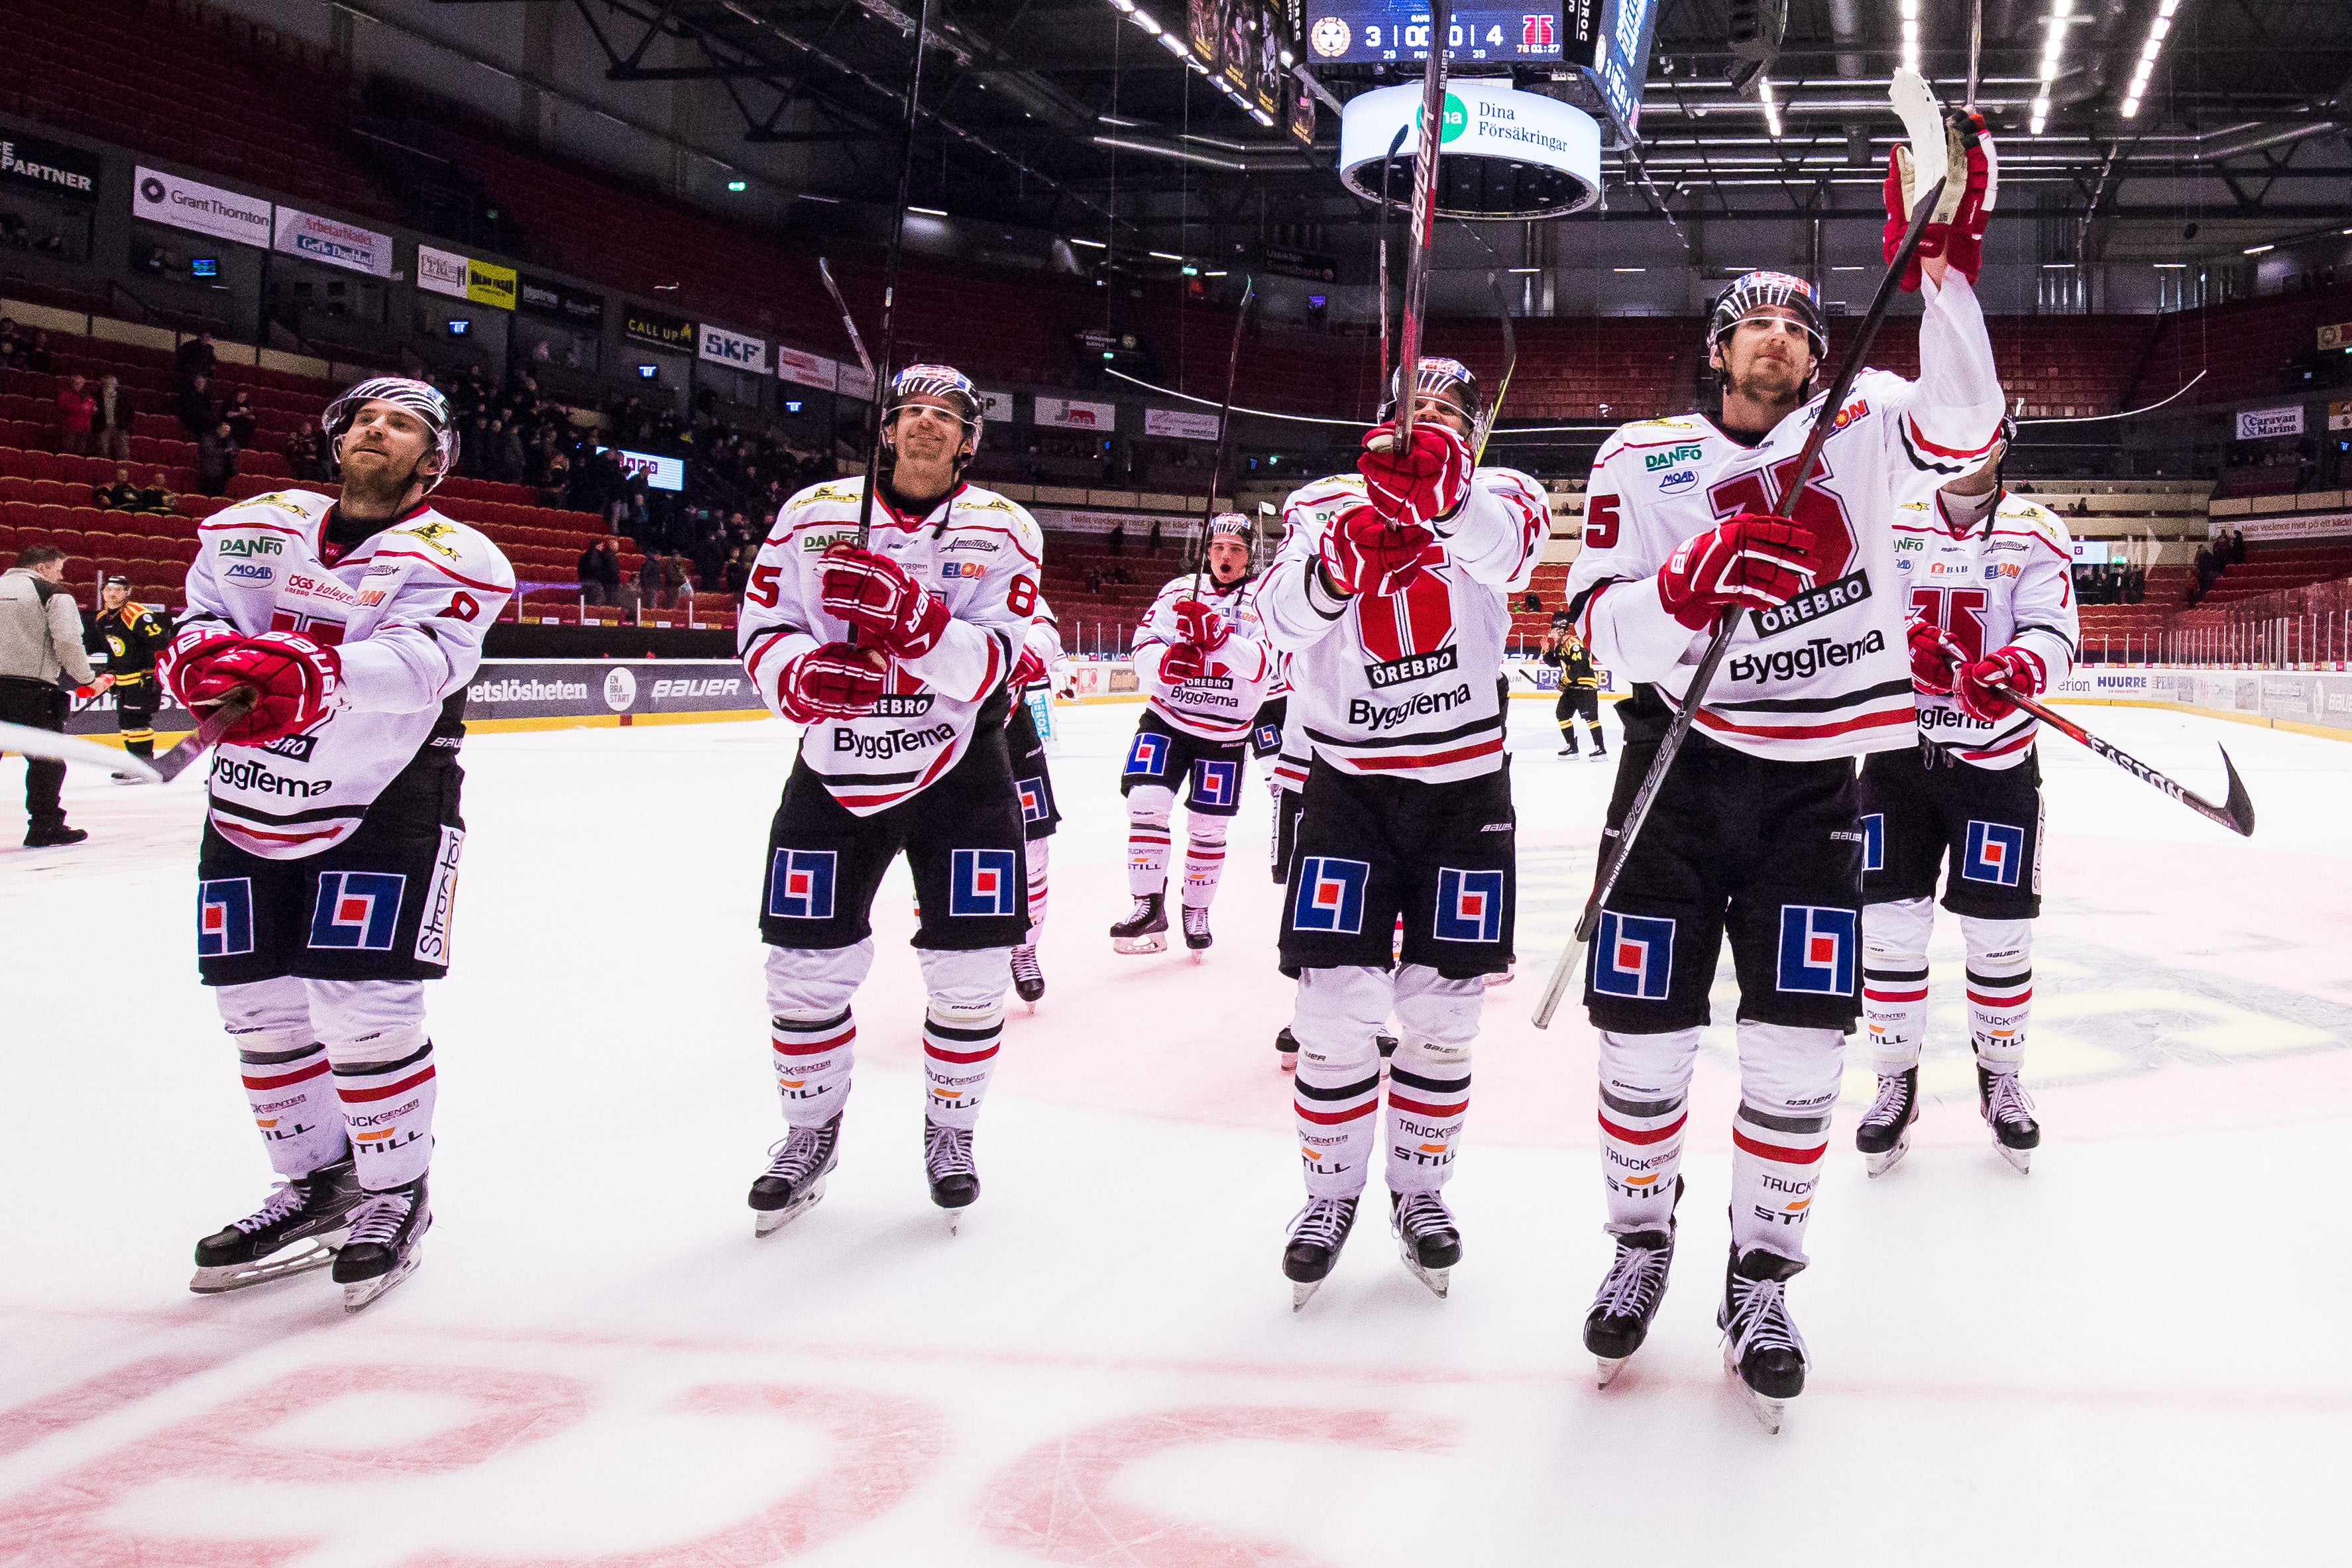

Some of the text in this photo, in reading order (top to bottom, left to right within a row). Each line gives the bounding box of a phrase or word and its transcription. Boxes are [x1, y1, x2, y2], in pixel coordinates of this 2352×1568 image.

[1366, 26, 1381, 46] 3
[1486, 25, 1503, 46] 4
[1443, 111, 1462, 125] na
[1479, 101, 1515, 120] Dina
[1478, 121, 1568, 152] Försäkringar
[1, 156, 91, 192] PARTNER
[171, 190, 270, 227] Grant Thornton
[628, 319, 678, 340] CALL UP
[705, 333, 761, 363] SKF
[2249, 415, 2296, 426] Caravan
[2257, 424, 2297, 435] Marine
[1645, 444, 1703, 472] DANFO
[1659, 469, 1695, 488] MOAB
[1585, 494, 1621, 549] 5
[219, 536, 286, 557] DANFO
[224, 564, 273, 580] MOAB
[941, 562, 989, 581] ELON
[1984, 563, 2022, 580] ELON
[313, 582, 354, 603] bolage
[746, 564, 783, 608] 5
[1009, 574, 1038, 618] 8
[1760, 578, 1864, 632] ÖREBRO
[1729, 629, 1885, 684] ByggTema
[1372, 653, 1452, 686] ÖREBRO
[651, 679, 741, 698] BAUER
[2097, 676, 2147, 688] HUURRE
[610, 693, 630, 703] START
[871, 698, 929, 716] EBRO
[1170, 686, 1239, 707] ByggTema
[1349, 684, 1471, 731] ByggTema
[431, 737, 465, 747] BAU
[834, 723, 956, 759] ByggTema
[212, 756, 333, 798] yggTema
[2090, 738, 2186, 803] EASTON
[775, 1085, 832, 1099] TILL
[355, 1130, 423, 1154] TILL
[1302, 1158, 1351, 1175] TILL
